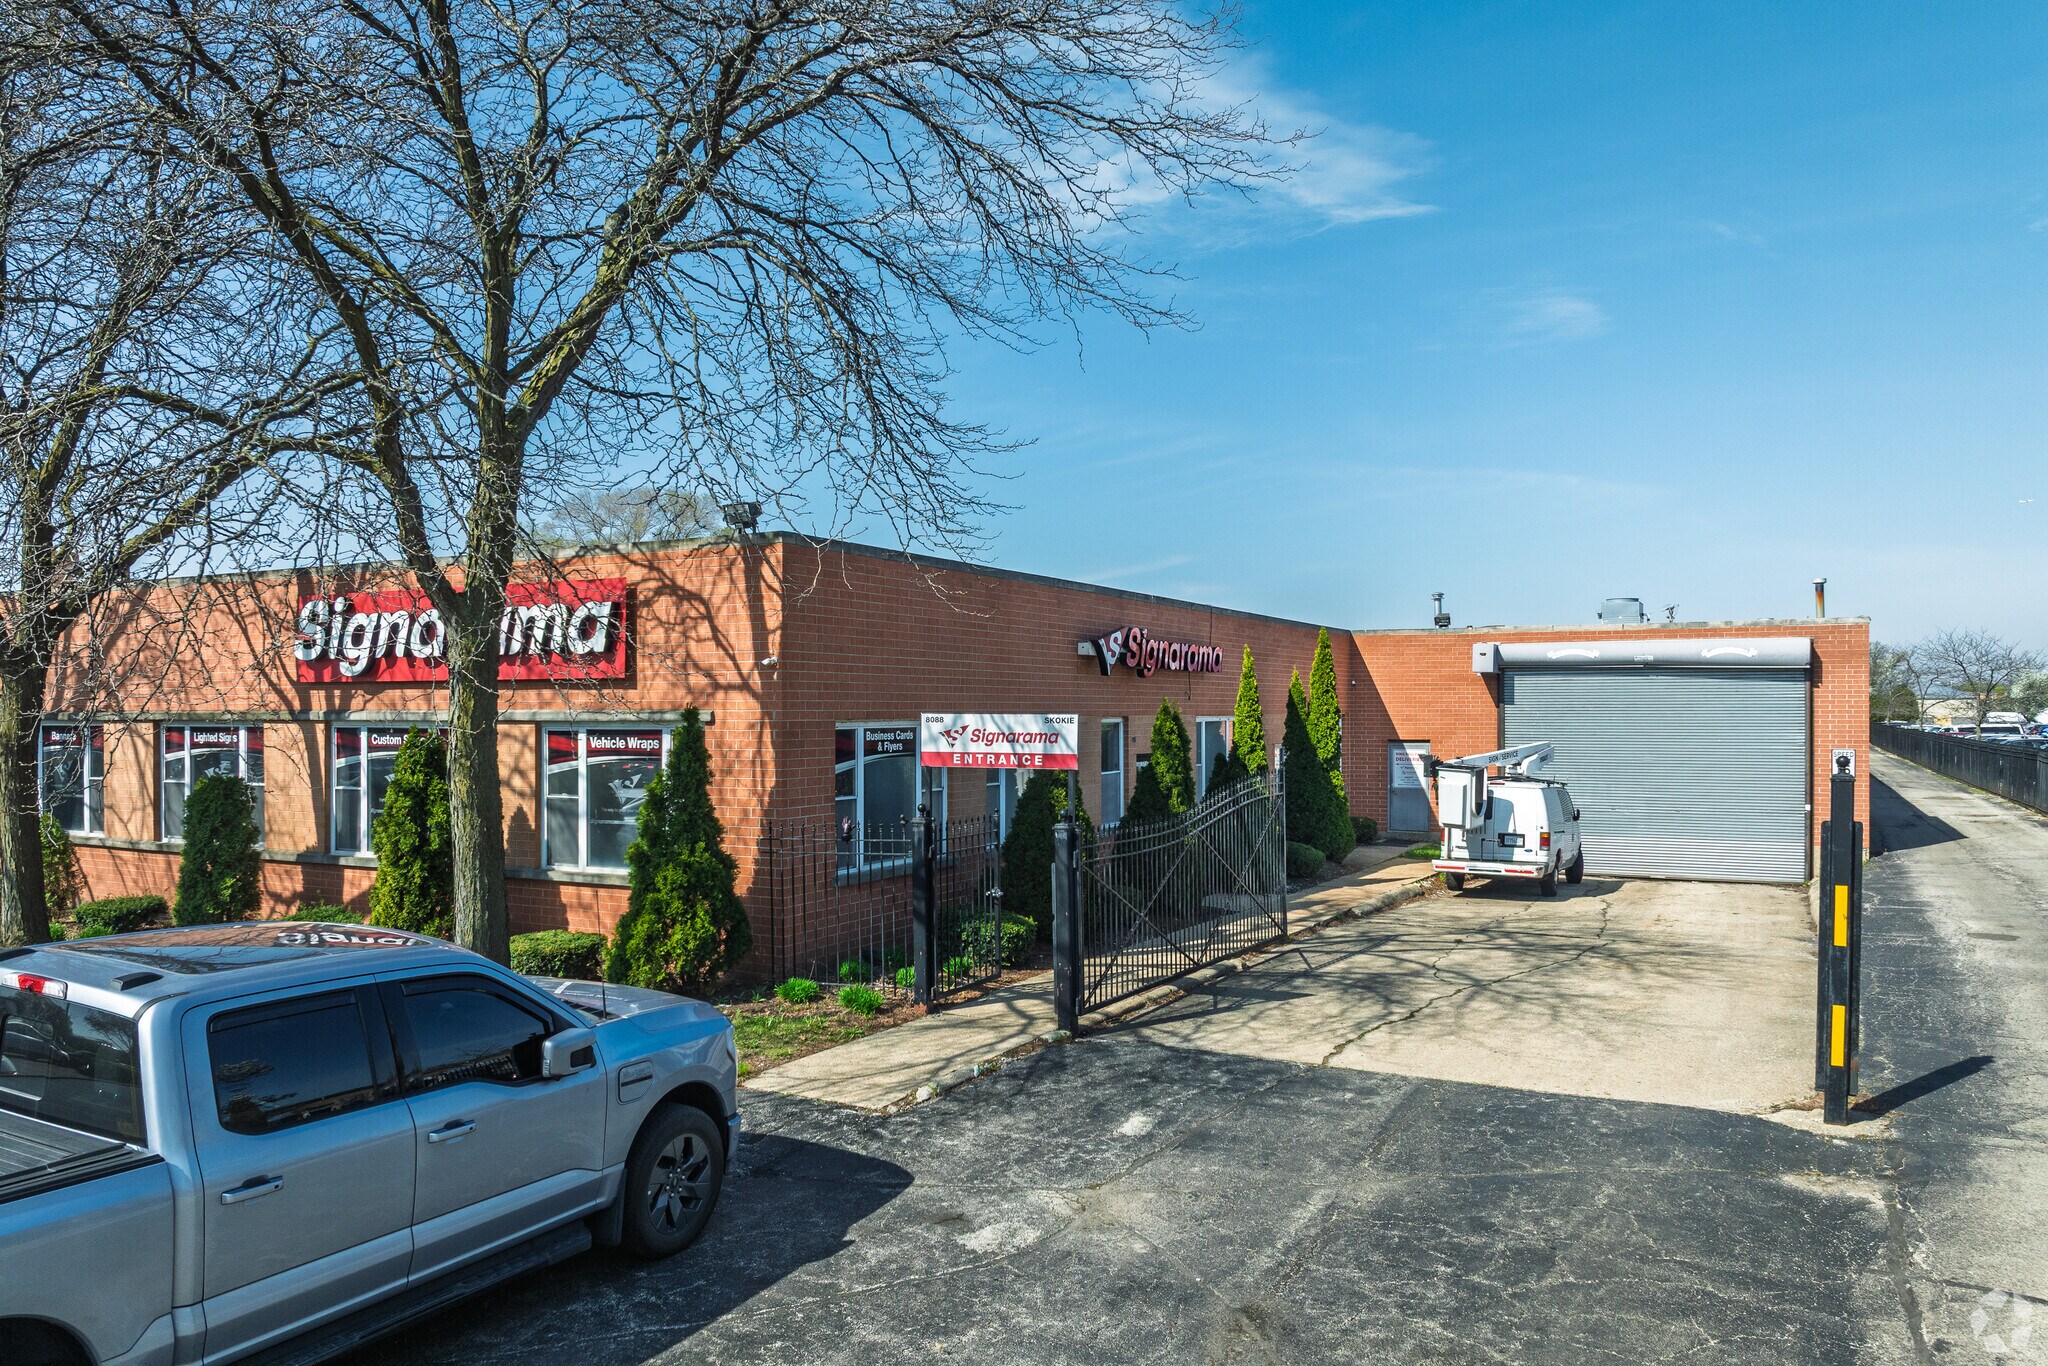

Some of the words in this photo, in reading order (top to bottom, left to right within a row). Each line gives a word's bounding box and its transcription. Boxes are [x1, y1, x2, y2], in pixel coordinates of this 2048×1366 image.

[293, 597, 613, 677] Signama
[1126, 627, 1223, 678] Signarama
[1044, 716, 1075, 724] SKOKIE
[193, 732, 218, 744] Lighted
[371, 734, 402, 745] Custom
[865, 731, 895, 741] Business
[895, 730, 914, 740] Cards
[969, 728, 1060, 747] Signarama
[590, 736, 625, 749] Vehicle
[627, 736, 660, 751] Wraps
[877, 741, 883, 751] &
[884, 741, 903, 753] Flyers
[953, 753, 1043, 766] ENTRANCE
[1488, 755, 1499, 764] SIGN
[1501, 750, 1518, 760] SERVICE
